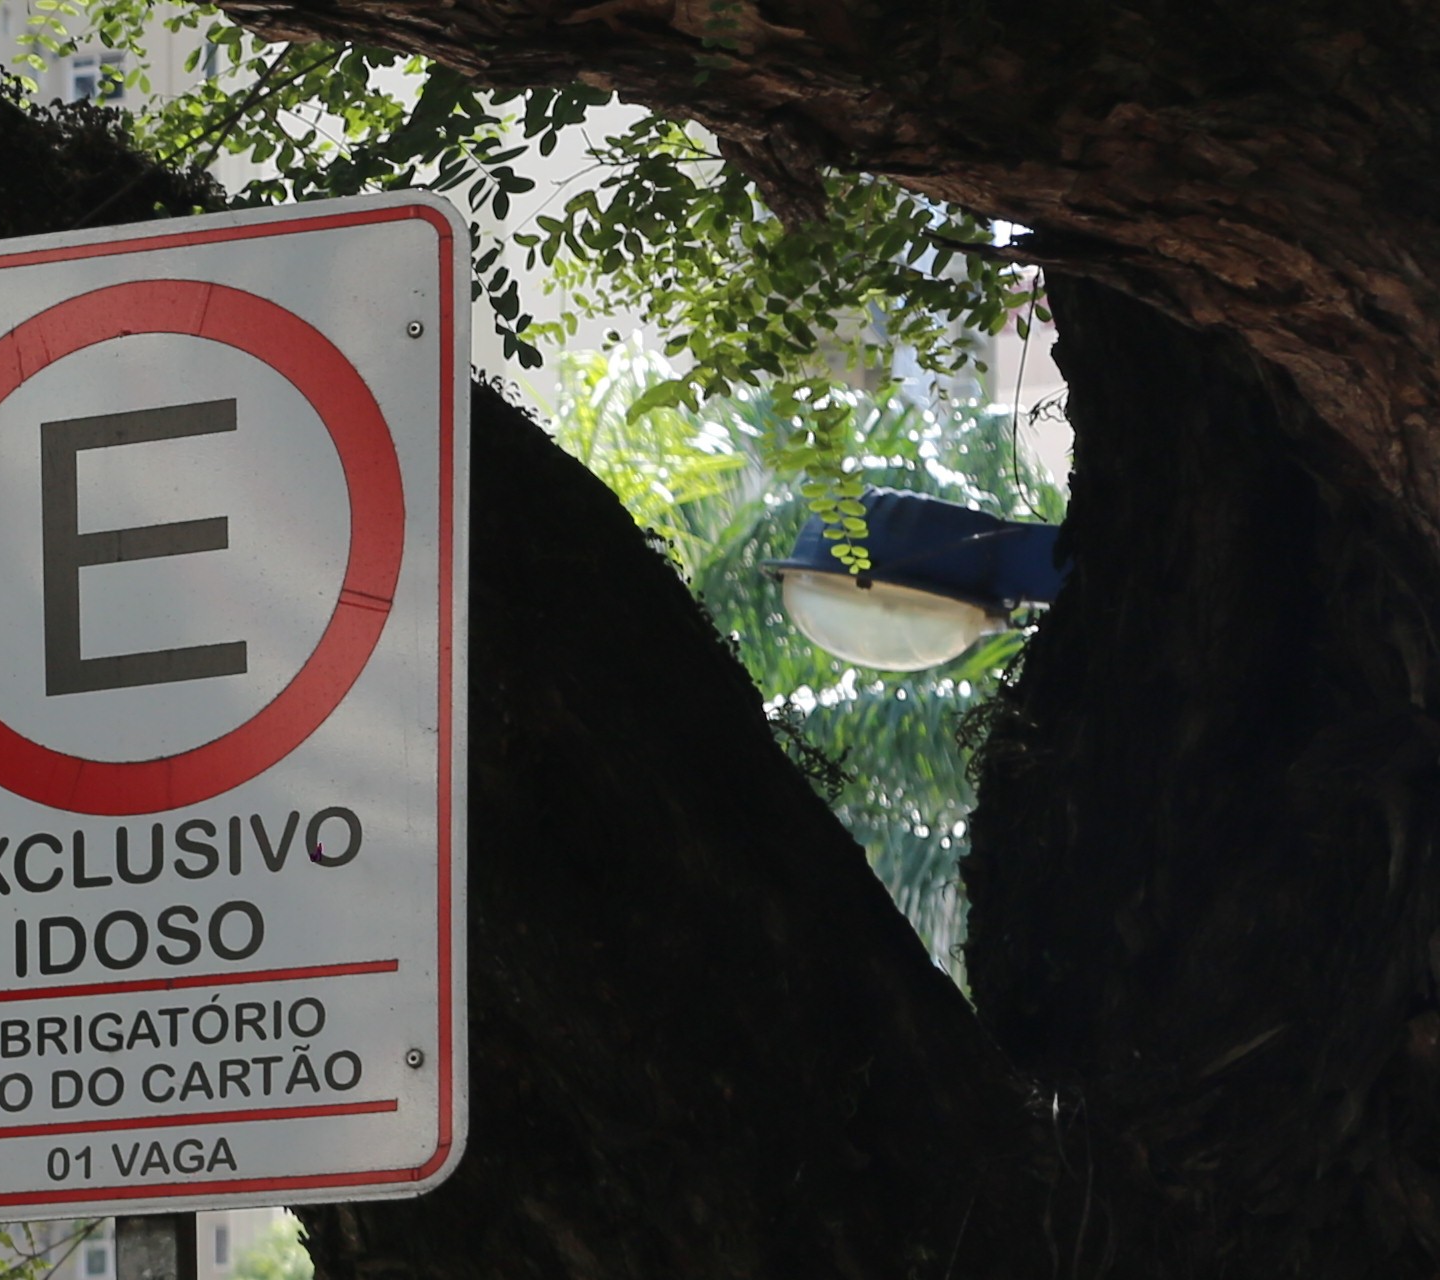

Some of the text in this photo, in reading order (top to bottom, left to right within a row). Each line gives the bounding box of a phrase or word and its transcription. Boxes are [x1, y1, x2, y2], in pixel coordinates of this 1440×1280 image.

[41, 397, 248, 697] E
[15, 899, 266, 979] IDOSO
[51, 1066, 125, 1110] DO
[141, 1043, 364, 1104] CARTÃO
[46, 1136, 238, 1182] 01 VAGA
